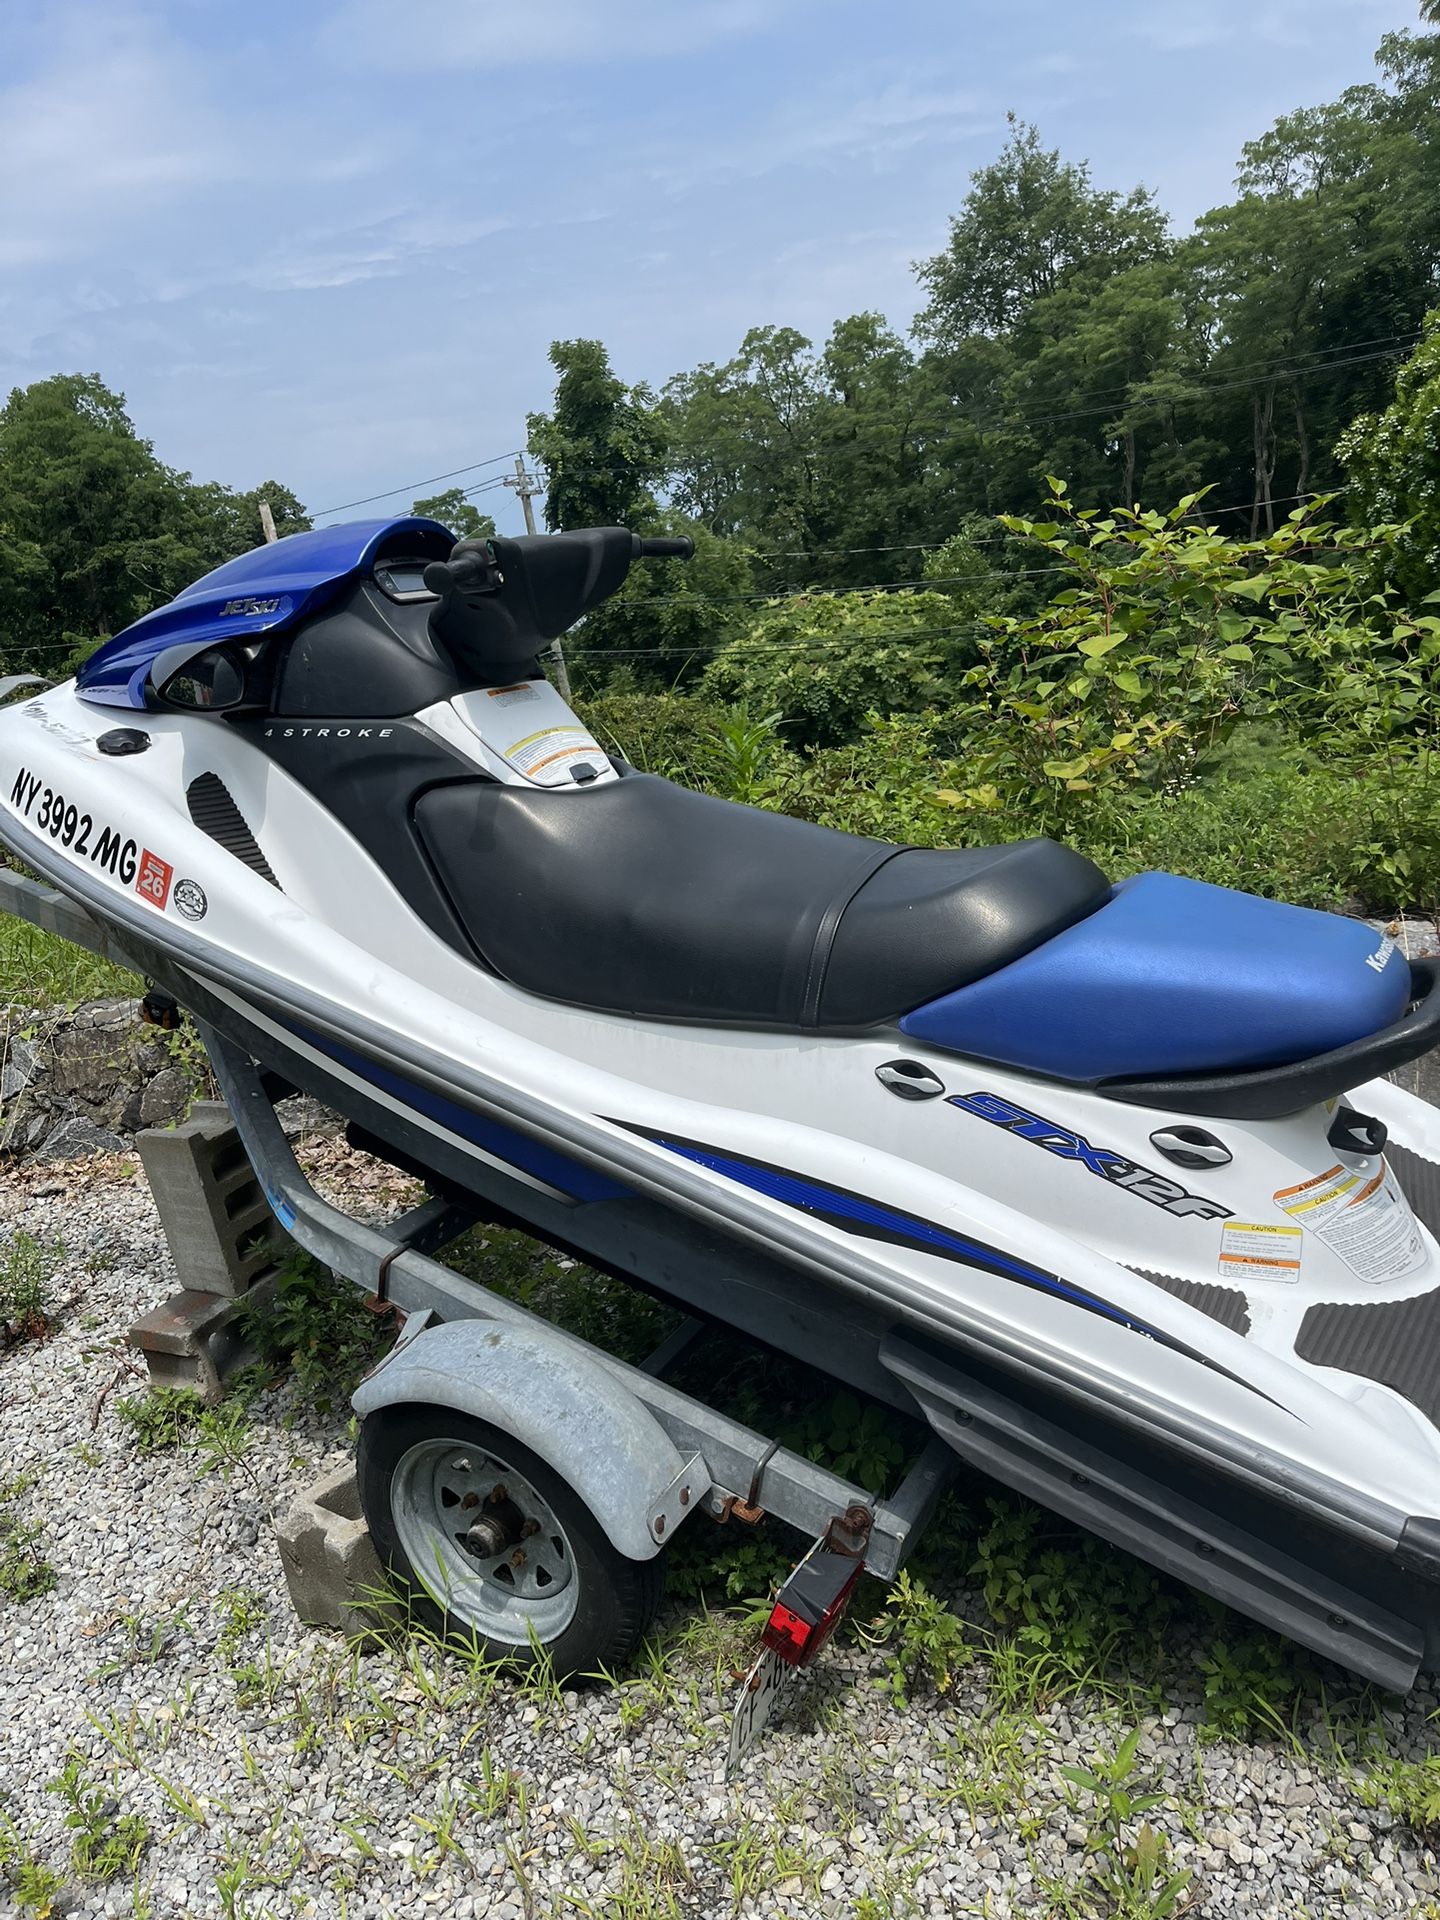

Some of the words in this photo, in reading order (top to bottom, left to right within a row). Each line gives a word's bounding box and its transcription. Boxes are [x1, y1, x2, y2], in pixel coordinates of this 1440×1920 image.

[264, 728, 273, 737] 4
[283, 728, 393, 738] STROKE
[10, 767, 42, 816] NY
[37, 788, 93, 856] 3992
[90, 826, 137, 885] MG
[141, 868, 165, 898] 26
[1314, 1191, 1338, 1205] CAUTION
[1251, 1225, 1277, 1233] CAUTION
[1250, 1258, 1279, 1266] WARNING
